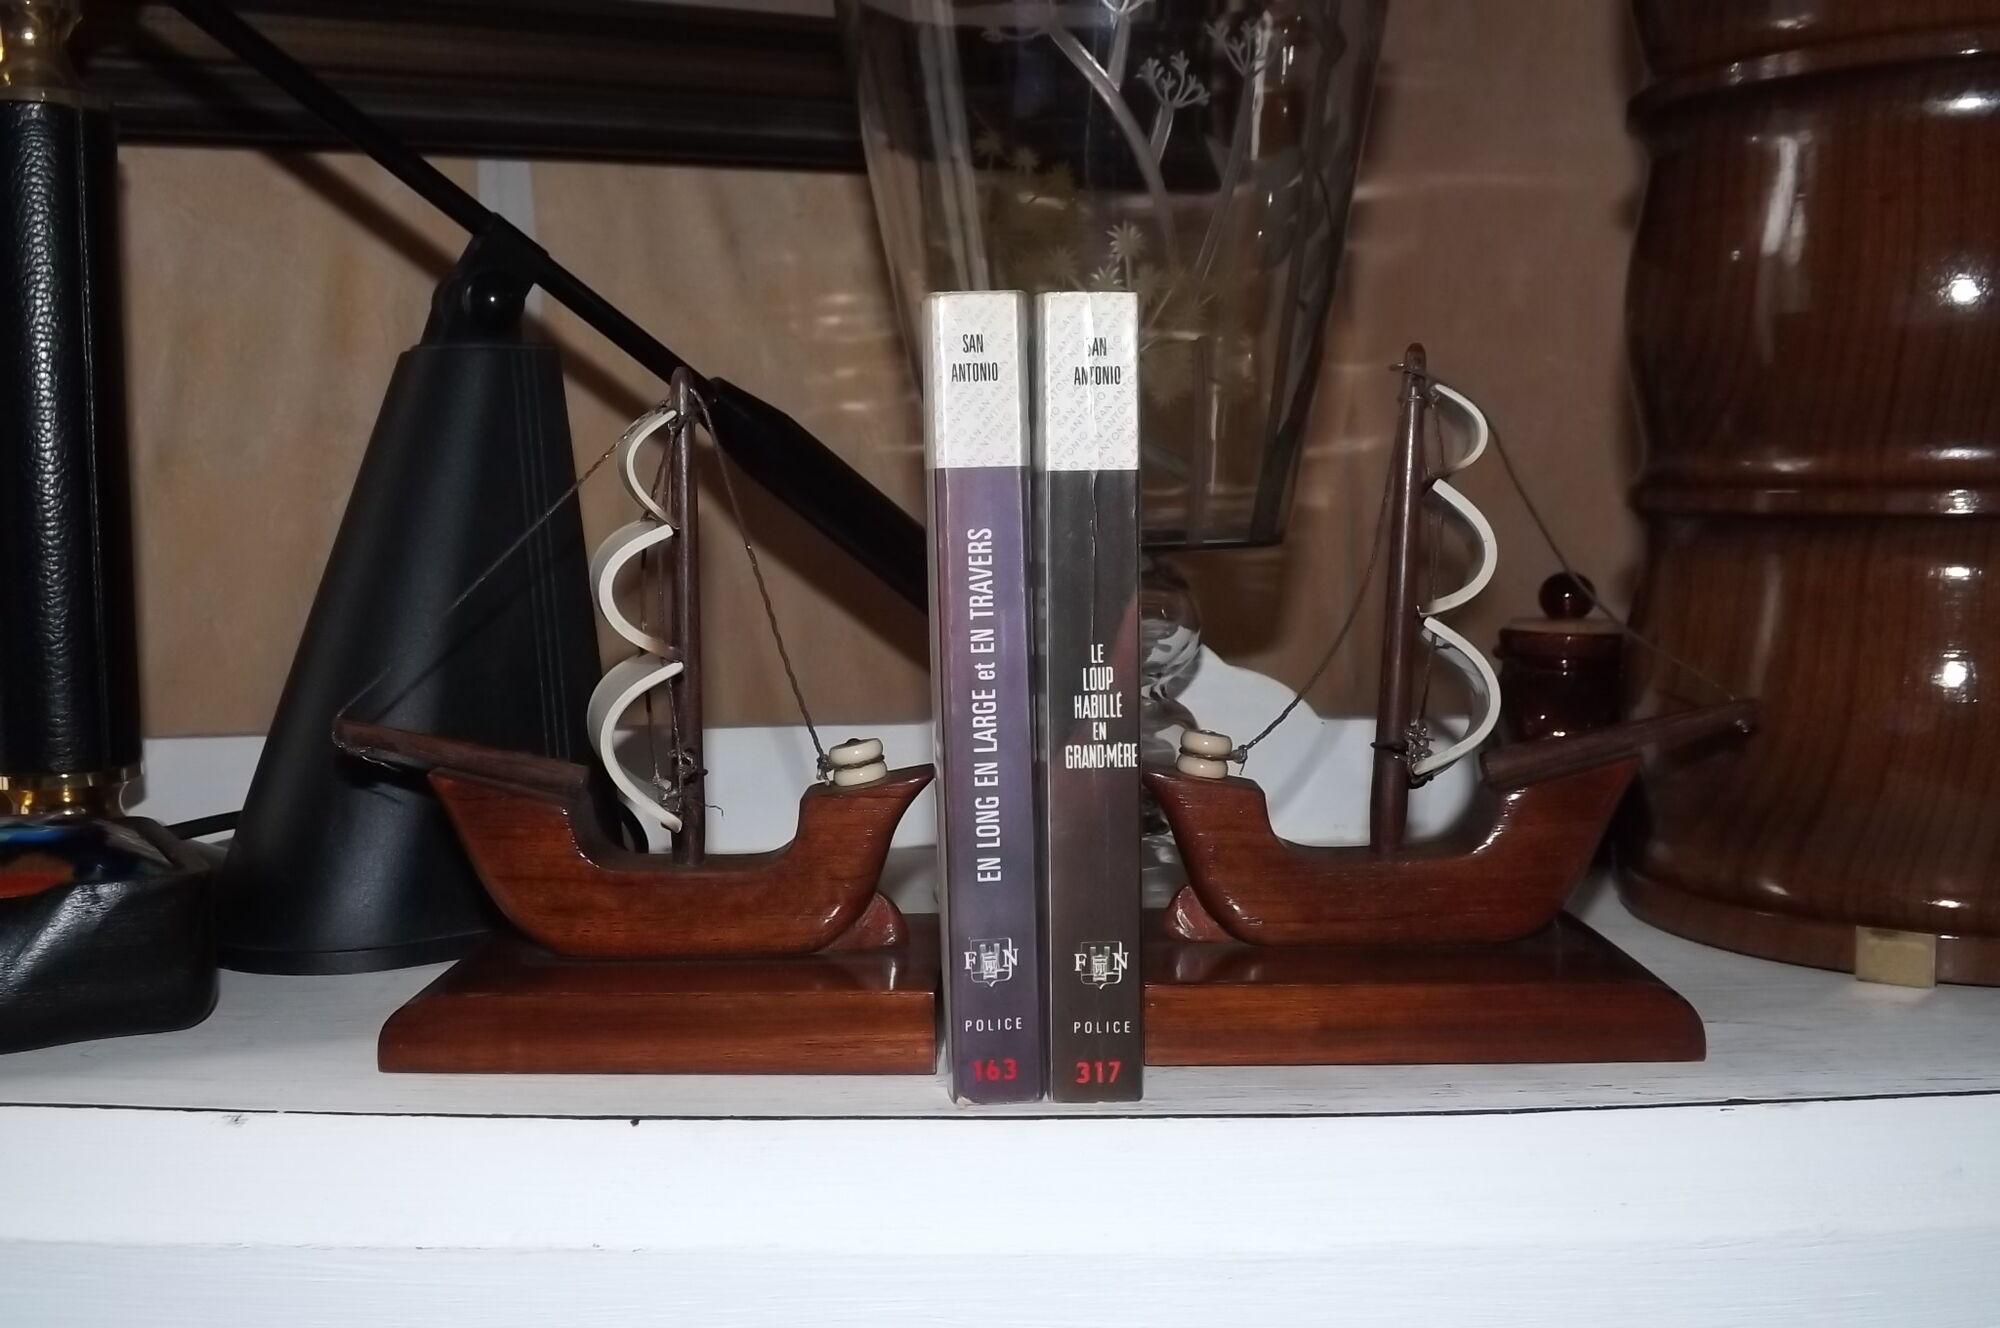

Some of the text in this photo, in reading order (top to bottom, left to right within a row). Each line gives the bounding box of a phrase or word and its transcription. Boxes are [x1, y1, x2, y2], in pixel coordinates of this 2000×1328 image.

[963, 334, 983, 353] SAN
[951, 362, 999, 382] ANTONIO
[1091, 644, 1104, 664] LE
[1082, 666, 1114, 691] LOUP
[967, 527, 1001, 882] EN LONG EN LARGE et EN TRAVERS
[1073, 692, 1123, 719] HABILLÉ
[1092, 722, 1107, 741] EN
[965, 1017, 1023, 1033] POLICE
[1073, 1021, 1131, 1034] POLICE
[972, 1058, 1019, 1082] 163
[1075, 1061, 1122, 1084] 317
